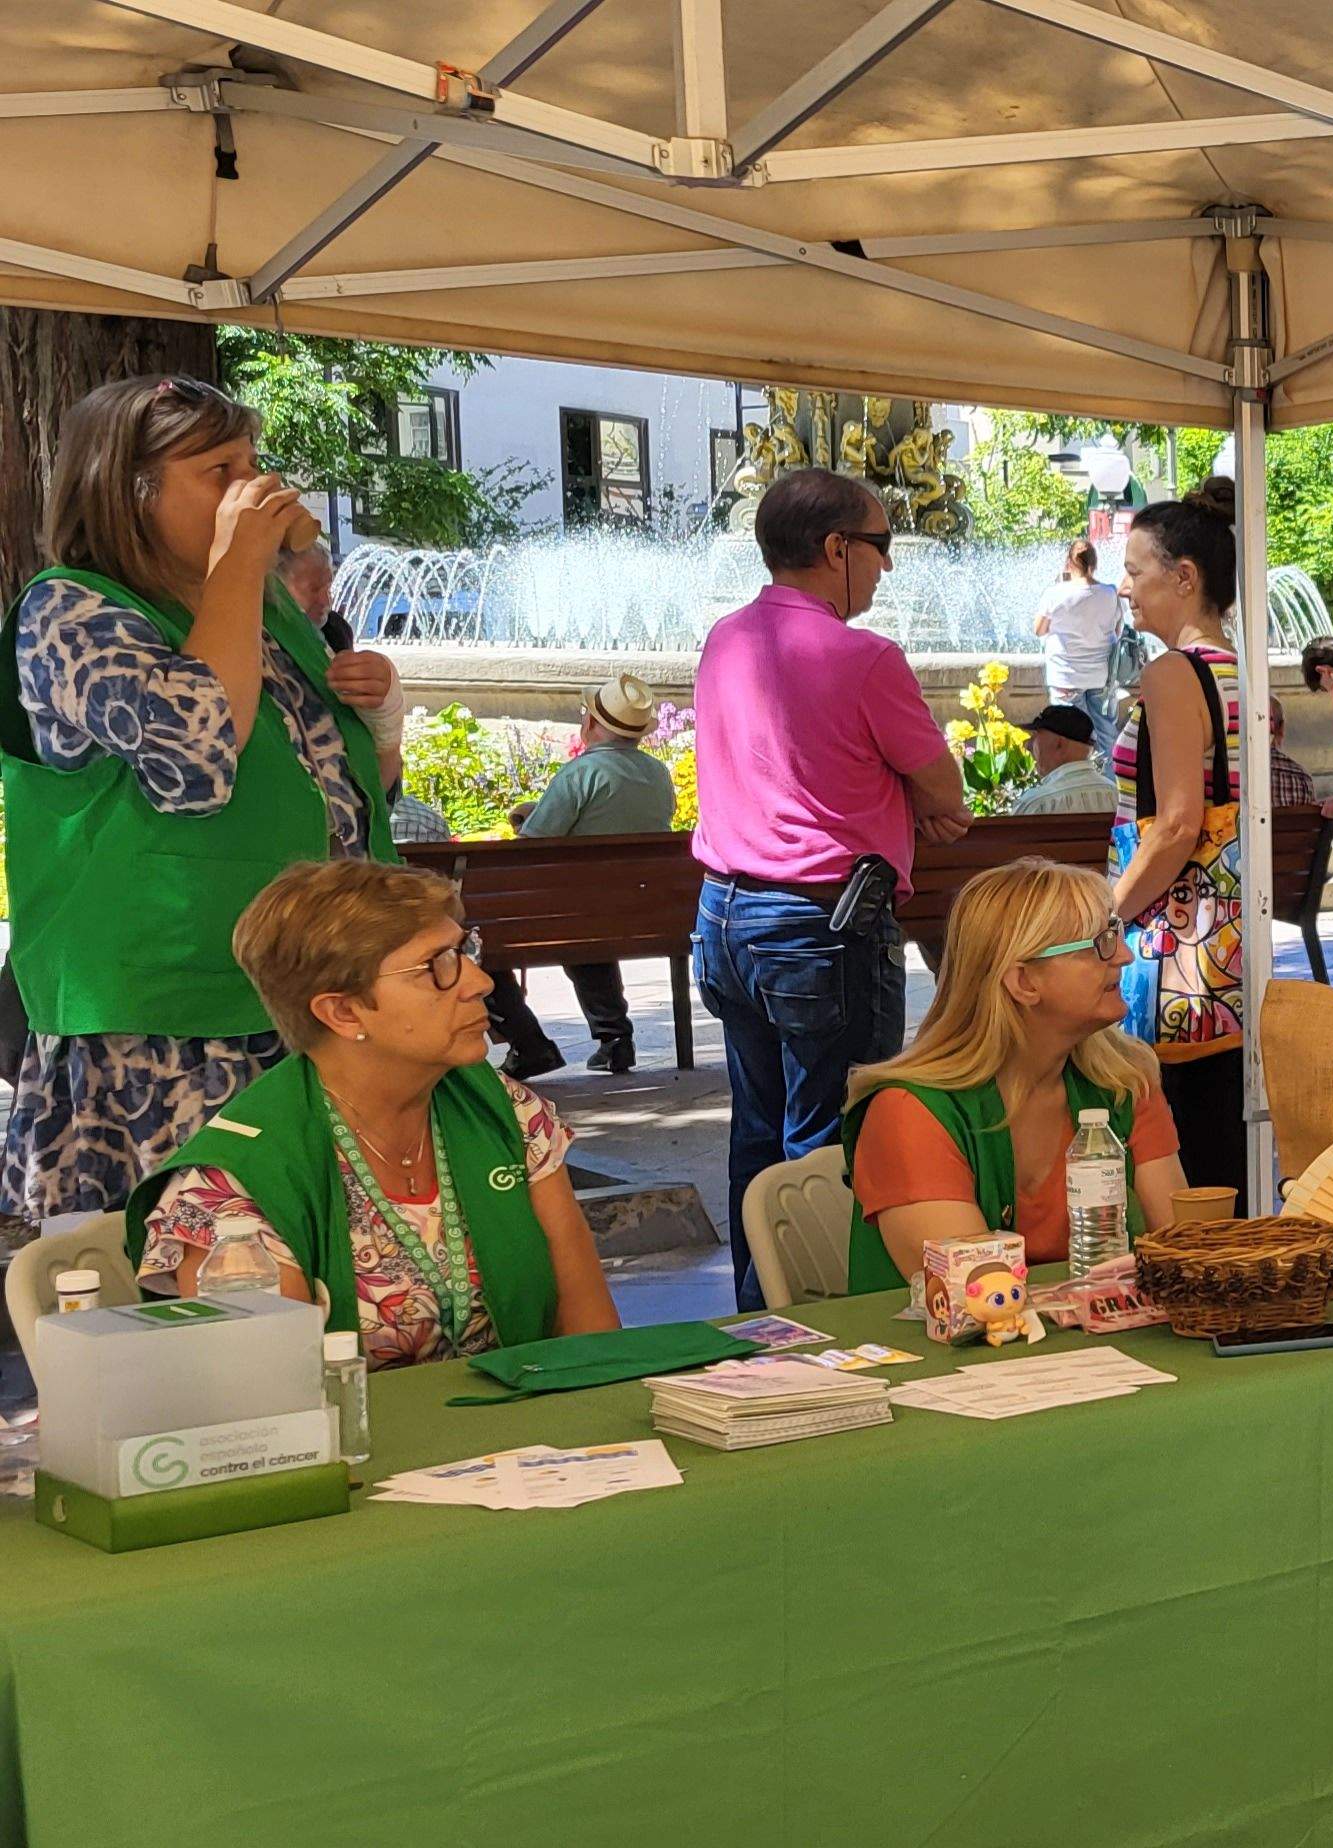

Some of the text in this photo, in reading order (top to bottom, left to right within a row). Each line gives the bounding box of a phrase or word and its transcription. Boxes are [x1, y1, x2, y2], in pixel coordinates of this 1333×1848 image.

[199, 1426, 279, 1447] asociación
[200, 1443, 269, 1462] española
[200, 1450, 320, 1478] contra el cáncer
